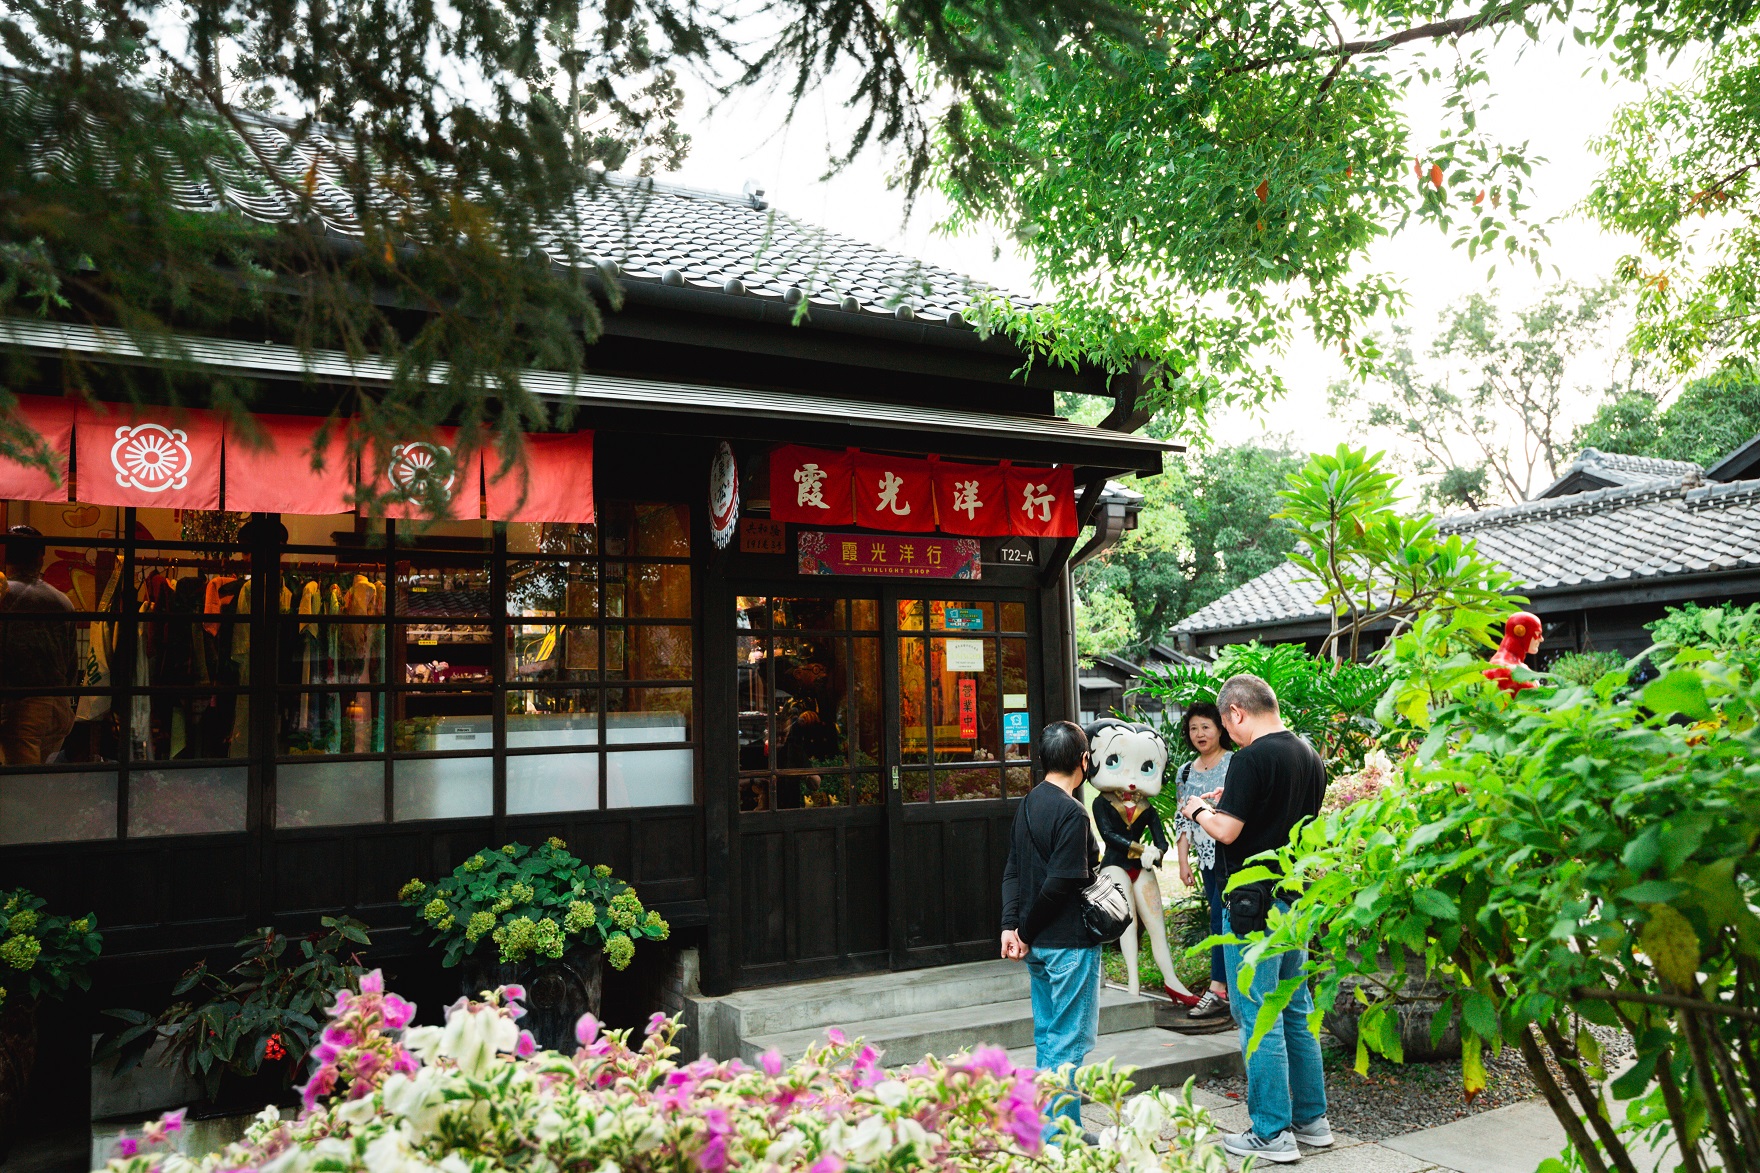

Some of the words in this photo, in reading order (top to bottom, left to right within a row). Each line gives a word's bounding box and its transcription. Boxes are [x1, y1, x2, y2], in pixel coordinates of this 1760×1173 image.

[793, 463, 1056, 523] 霞光洋行
[841, 541, 942, 564] 霞光洋行
[1001, 548, 1034, 562] T22-A
[861, 566, 905, 574] SUNLIGHT
[961, 684, 973, 728] 營業中
